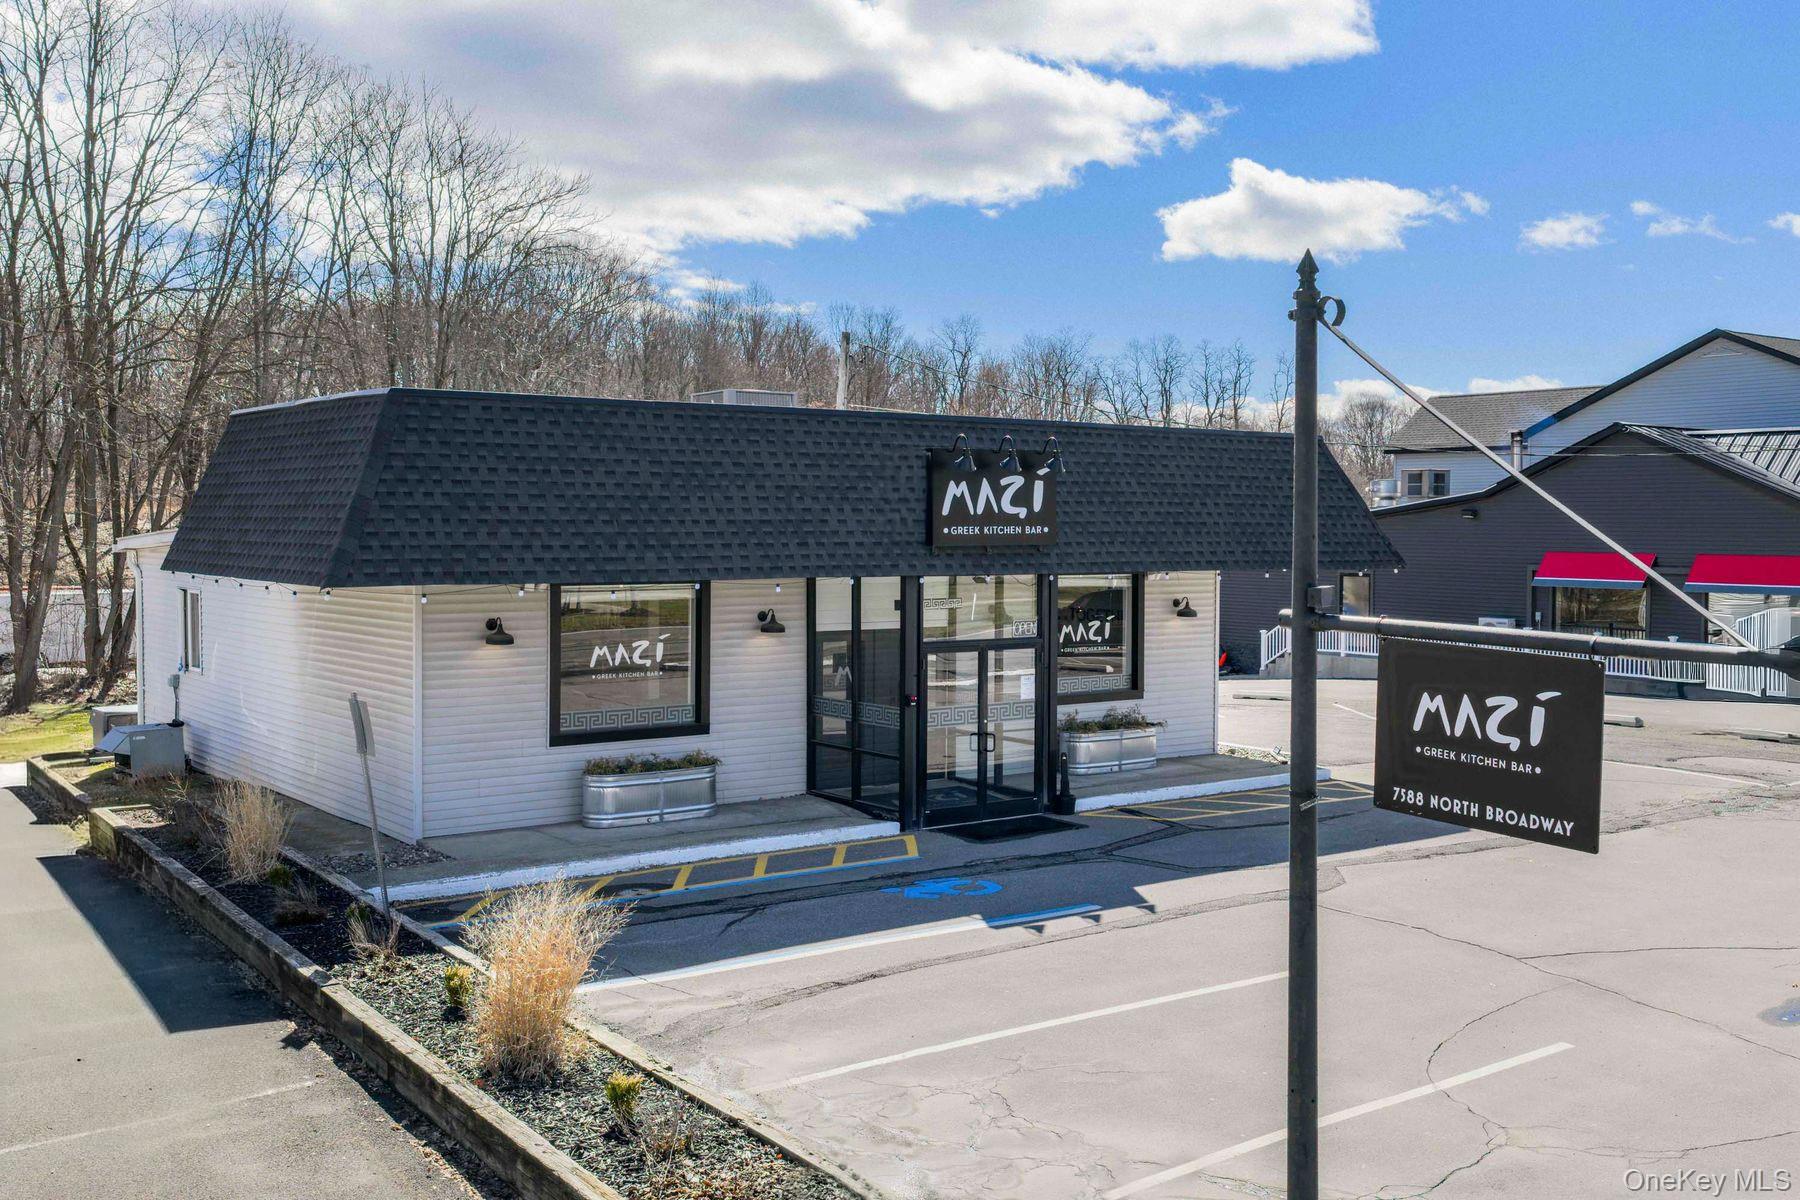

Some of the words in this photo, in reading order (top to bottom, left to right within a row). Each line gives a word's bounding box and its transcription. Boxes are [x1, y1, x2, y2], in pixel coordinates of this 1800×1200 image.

[950, 526, 980, 535] GREEK
[984, 526, 1022, 534] KITCHEN
[1025, 525, 1042, 534] BAR
[1013, 620, 1037, 636] OPEN
[1423, 746, 1456, 761] GREEK
[1460, 752, 1506, 769] KITCHEN
[1511, 761, 1532, 774] BAR
[1392, 786, 1424, 807] 7588
[1430, 794, 1479, 818] NORTH
[1486, 806, 1575, 837] BROADWAY
